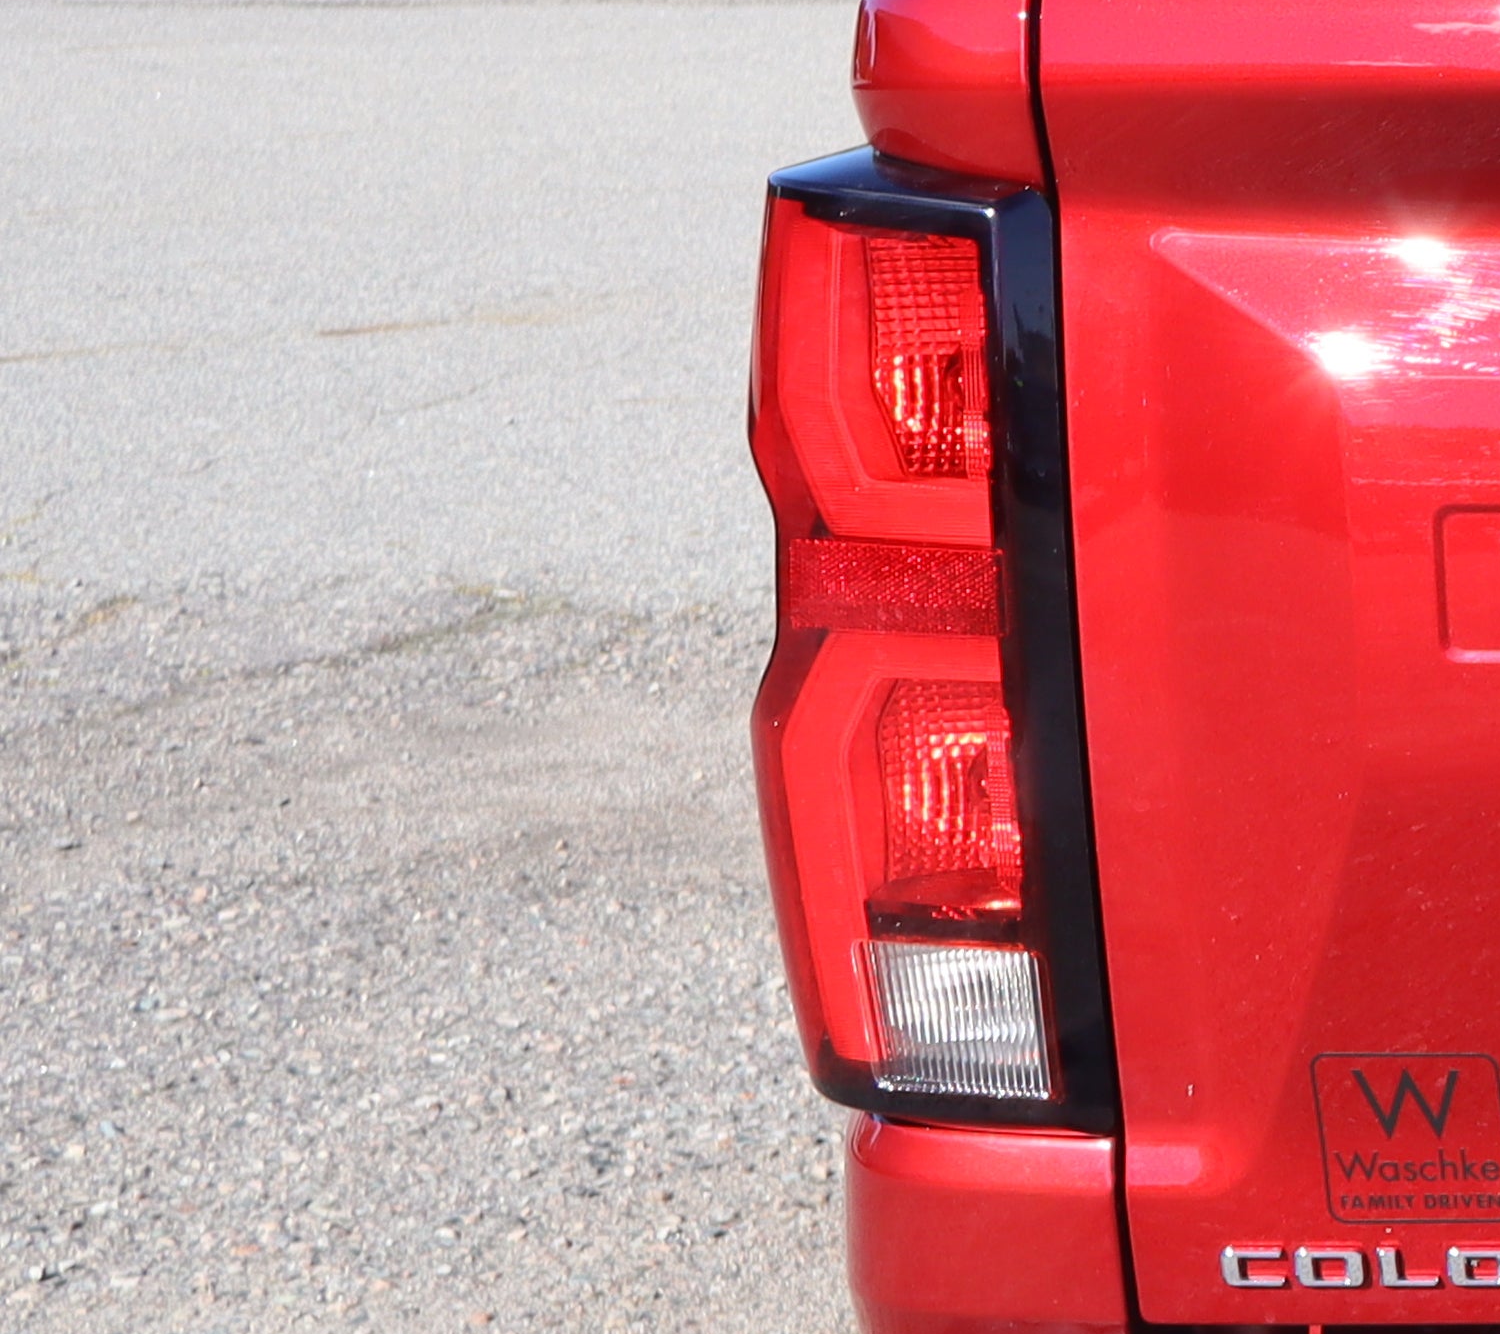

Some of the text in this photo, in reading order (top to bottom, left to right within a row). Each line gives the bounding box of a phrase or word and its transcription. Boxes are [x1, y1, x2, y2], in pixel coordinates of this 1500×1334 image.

[1354, 1069, 1459, 1138] W
[1335, 1148, 1500, 1182] Waschke
[1341, 1194, 1416, 1210] FAMILY
